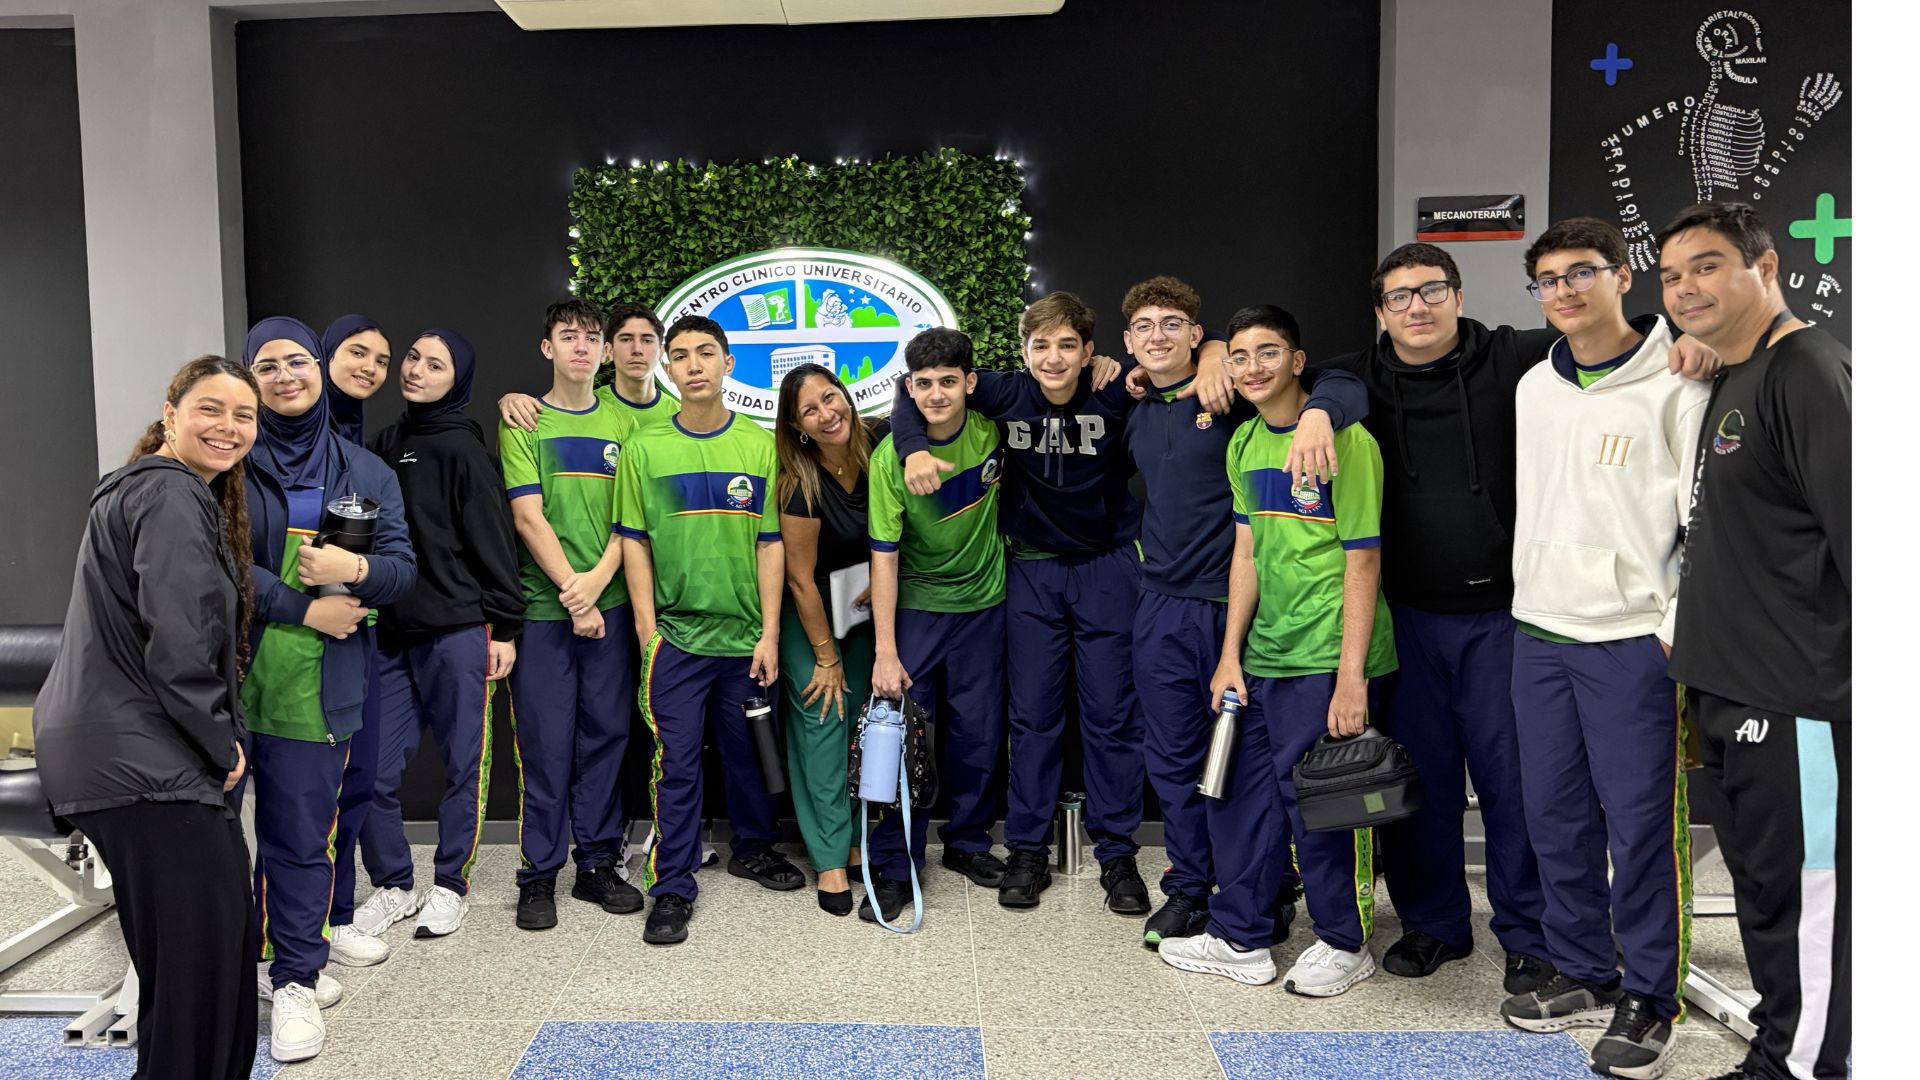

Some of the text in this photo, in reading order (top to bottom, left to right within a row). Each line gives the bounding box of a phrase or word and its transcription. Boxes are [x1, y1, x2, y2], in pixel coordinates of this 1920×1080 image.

[1700, 10, 1739, 32] PARIETAL
[1738, 11, 1762, 36] FRONTAL
[1735, 57, 1767, 65] MAXILAR
[1814, 72, 1834, 101] FALANGE
[1711, 109, 1737, 119] COSTILLA
[1607, 96, 1696, 147] HUMERO
[1710, 115, 1736, 125] COSTILLA
[1708, 121, 1734, 131] COSTILLA
[1707, 128, 1733, 138] COSTILLA
[1706, 134, 1732, 144] COSTILLA
[1706, 141, 1732, 150] COSTILLA
[1705, 147, 1731, 157] COSTILLA
[1707, 154, 1733, 164] COSTILLA
[1709, 160, 1735, 170] COSTILLA
[1710, 166, 1737, 176] COSTILLA
[1711, 173, 1738, 183] COSTILLA
[1713, 180, 1740, 190] COSTILLA
[1433, 209, 1512, 220] MECANOTERAPIA
[1628, 243, 1638, 271] FALANGE
[1635, 242, 1649, 272] FALANGE
[1641, 239, 1657, 265] FALANGE
[732, 264, 797, 287] CLINICO
[802, 264, 923, 314] UNIVERSITARIO
[1007, 414, 1105, 456] GAP
